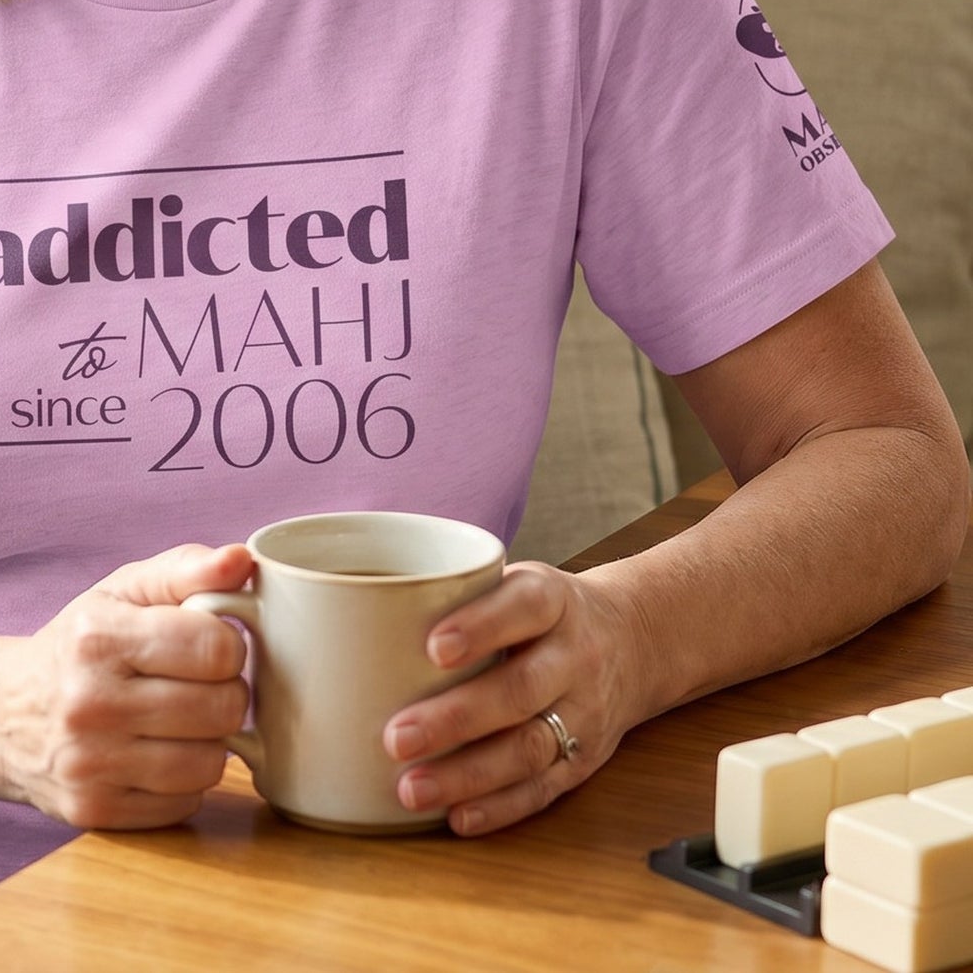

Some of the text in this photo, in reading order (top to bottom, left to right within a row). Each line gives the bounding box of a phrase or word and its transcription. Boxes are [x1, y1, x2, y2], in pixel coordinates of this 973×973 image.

[58, 279, 413, 381] to MAHJ
[10, 372, 416, 473] since 2006
